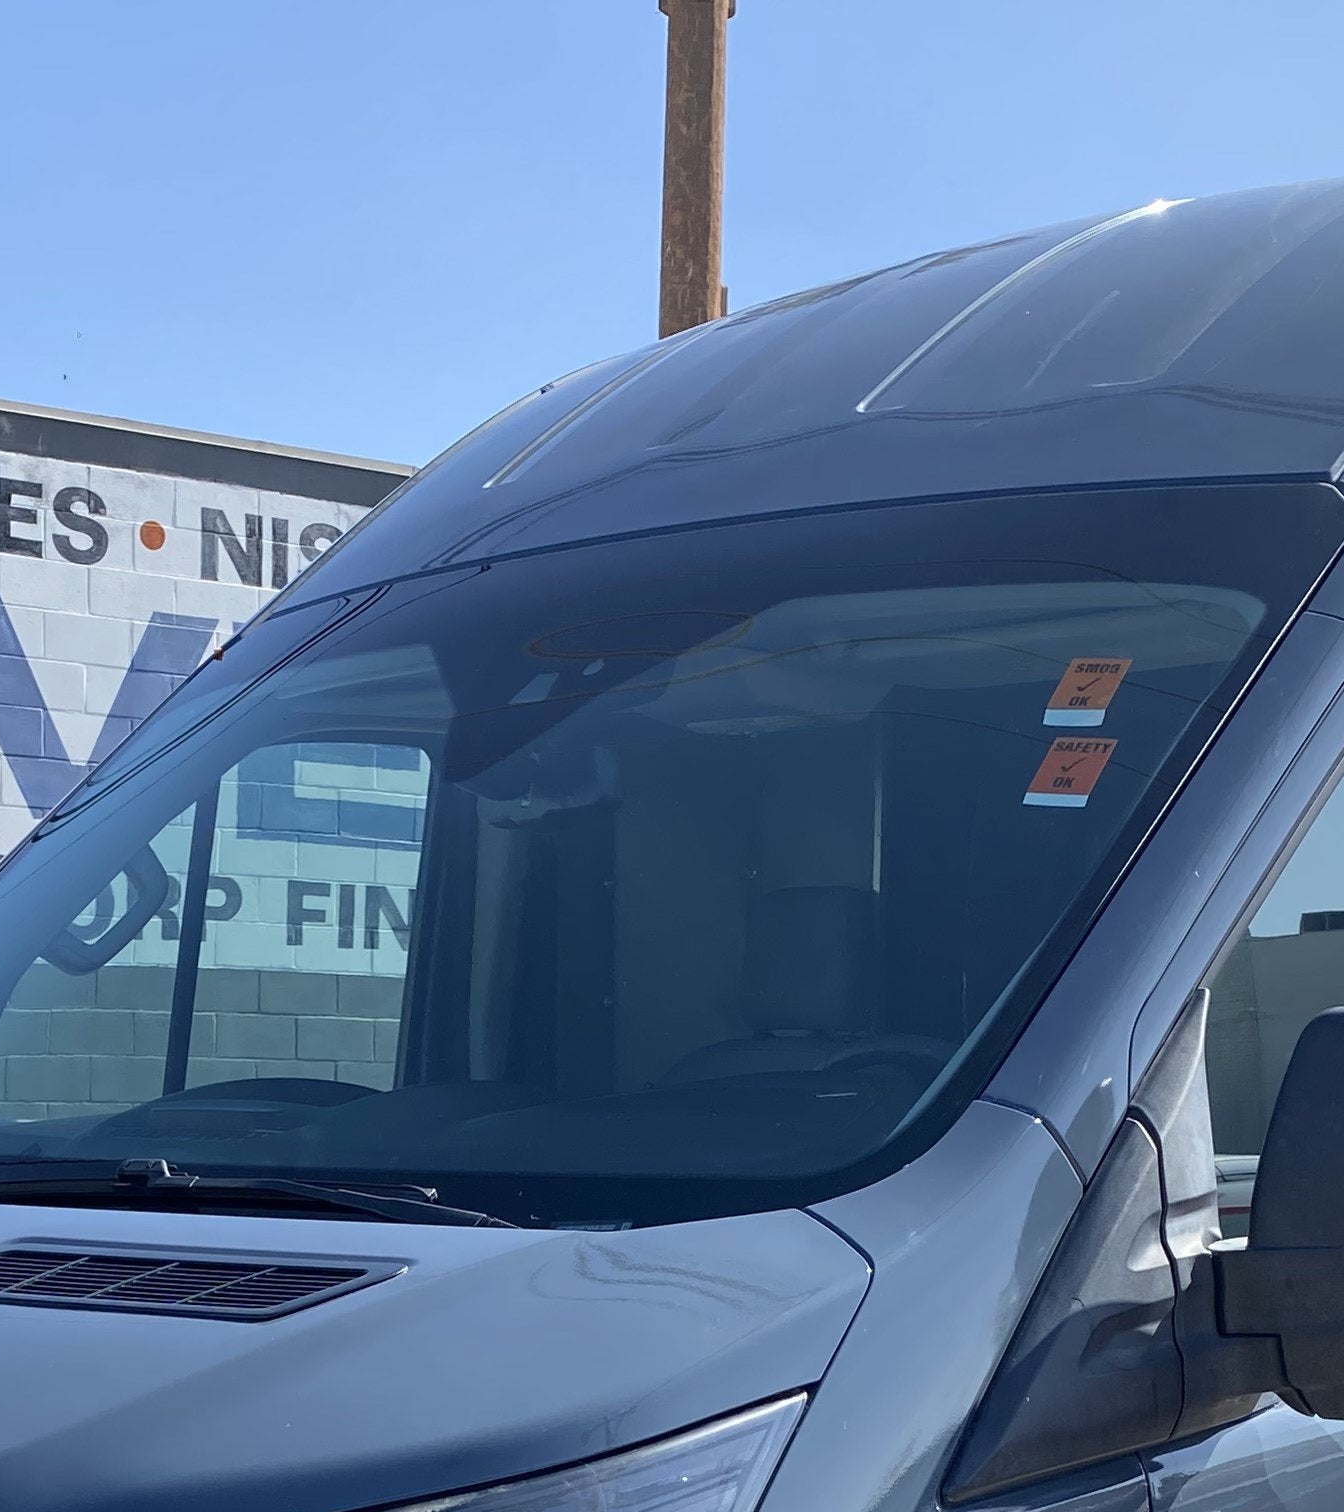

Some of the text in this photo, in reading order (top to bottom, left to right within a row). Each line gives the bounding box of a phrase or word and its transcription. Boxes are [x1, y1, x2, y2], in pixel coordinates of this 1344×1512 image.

[1074, 663, 1121, 674] SMOG
[1068, 696, 1091, 707] OK
[1054, 741, 1113, 753] SAFETY
[1053, 777, 1075, 788] OK
